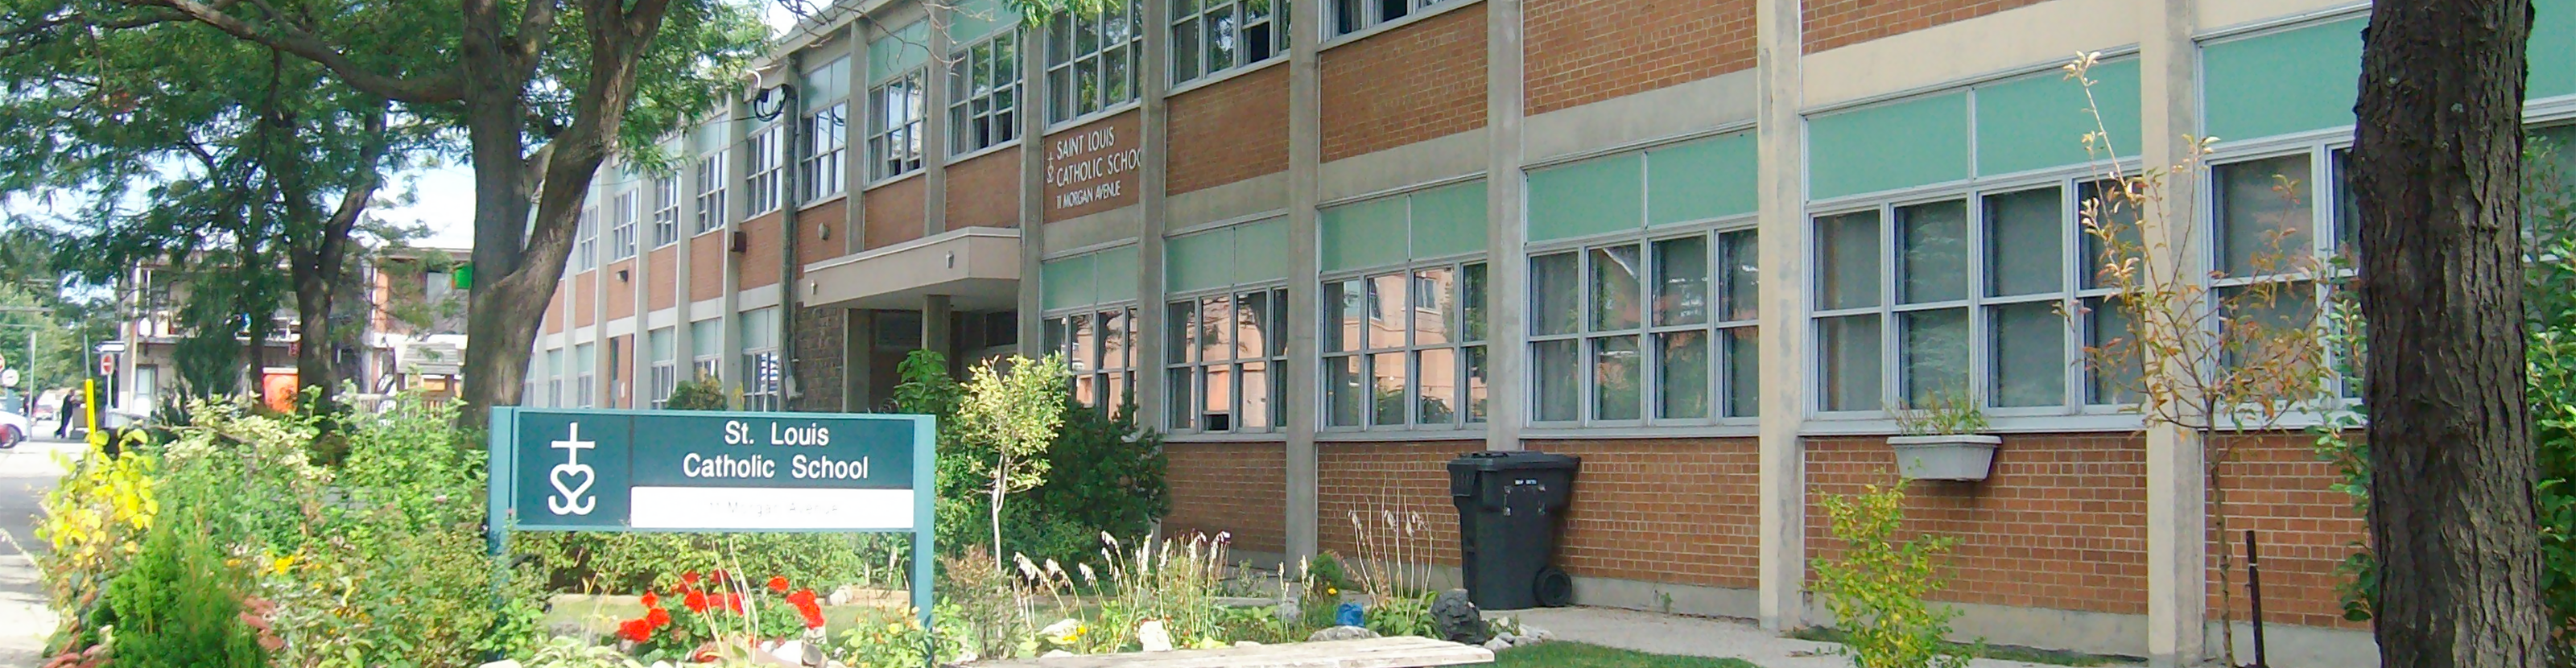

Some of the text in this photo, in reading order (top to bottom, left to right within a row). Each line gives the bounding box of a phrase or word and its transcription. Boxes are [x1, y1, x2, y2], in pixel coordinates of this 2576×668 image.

[1057, 126, 1114, 160] SAINT LOUIS
[1057, 157, 1103, 187] CATHOLIC
[1063, 187, 1093, 208] MORGAN
[1095, 180, 1121, 201] AVENUE
[724, 420, 829, 446] St. Louis
[683, 452, 869, 479] Catholic School
